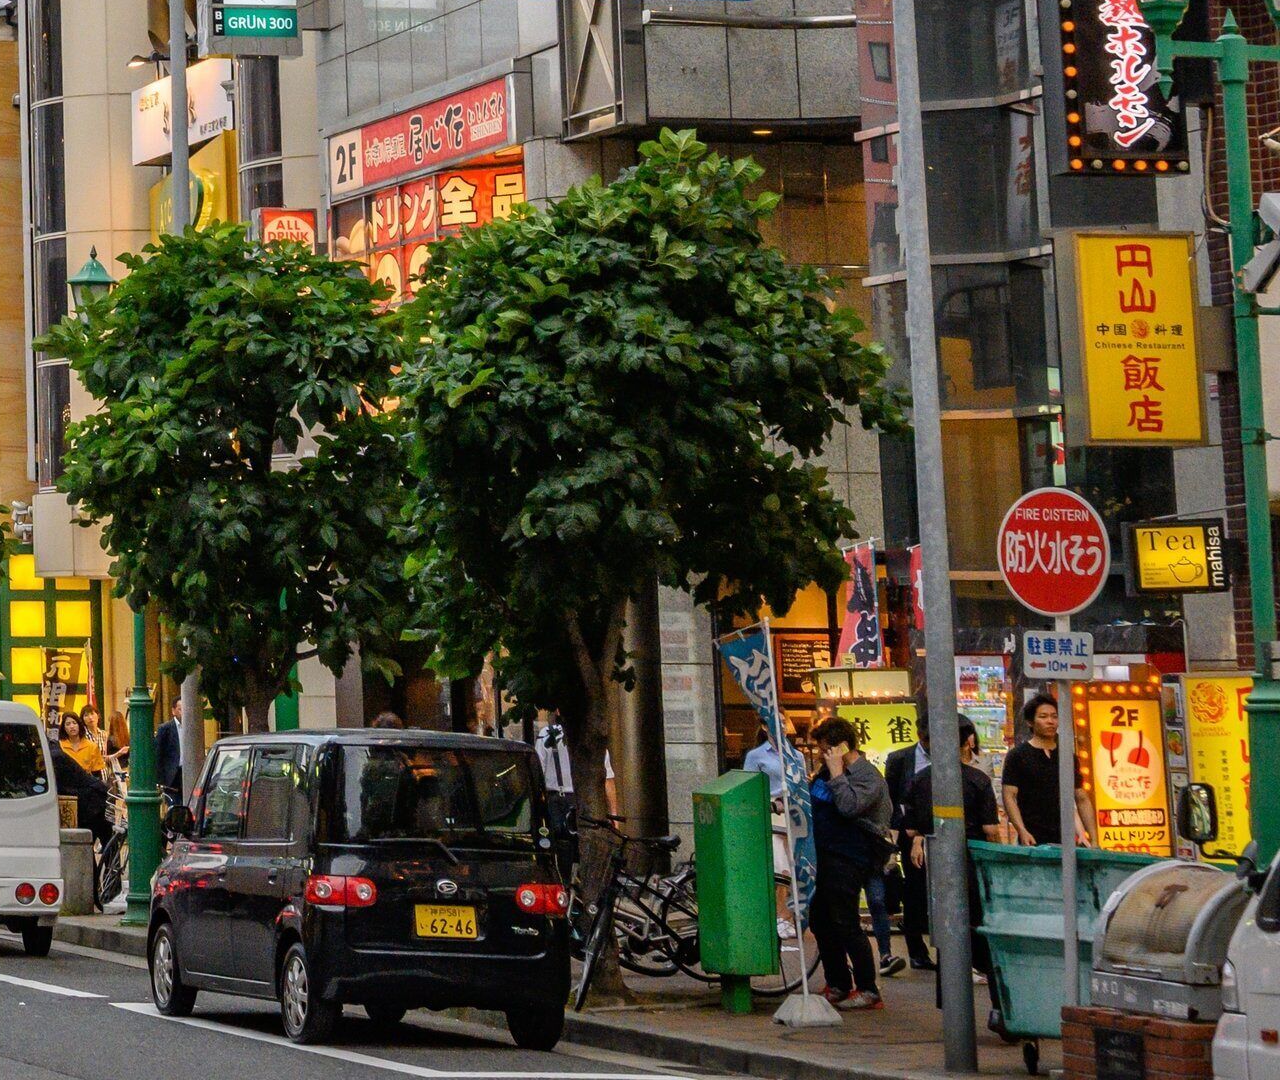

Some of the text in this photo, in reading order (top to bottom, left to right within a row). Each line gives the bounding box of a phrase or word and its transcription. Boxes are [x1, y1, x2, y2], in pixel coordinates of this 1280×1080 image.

[228, 14, 293, 30] GRÜN 300
[336, 141, 356, 185] 2F
[371, 172, 526, 244] ドリンク 全品
[276, 220, 301, 231] ALL
[267, 231, 309, 243] DRINK
[1096, 322, 1184, 338] 中国 料理
[1094, 341, 1186, 351] Chinese Restaurant
[1014, 507, 1090, 522] FIRE CISTERN
[1142, 529, 1197, 553] Tea
[1004, 530, 1102, 577] 防火水そう
[1206, 526, 1224, 587] mahisa
[1027, 636, 1088, 657] 駐車禁止
[1110, 705, 1139, 727] 2F
[429, 919, 474, 936] 62-46
[511, 926, 539, 936] Tanto
